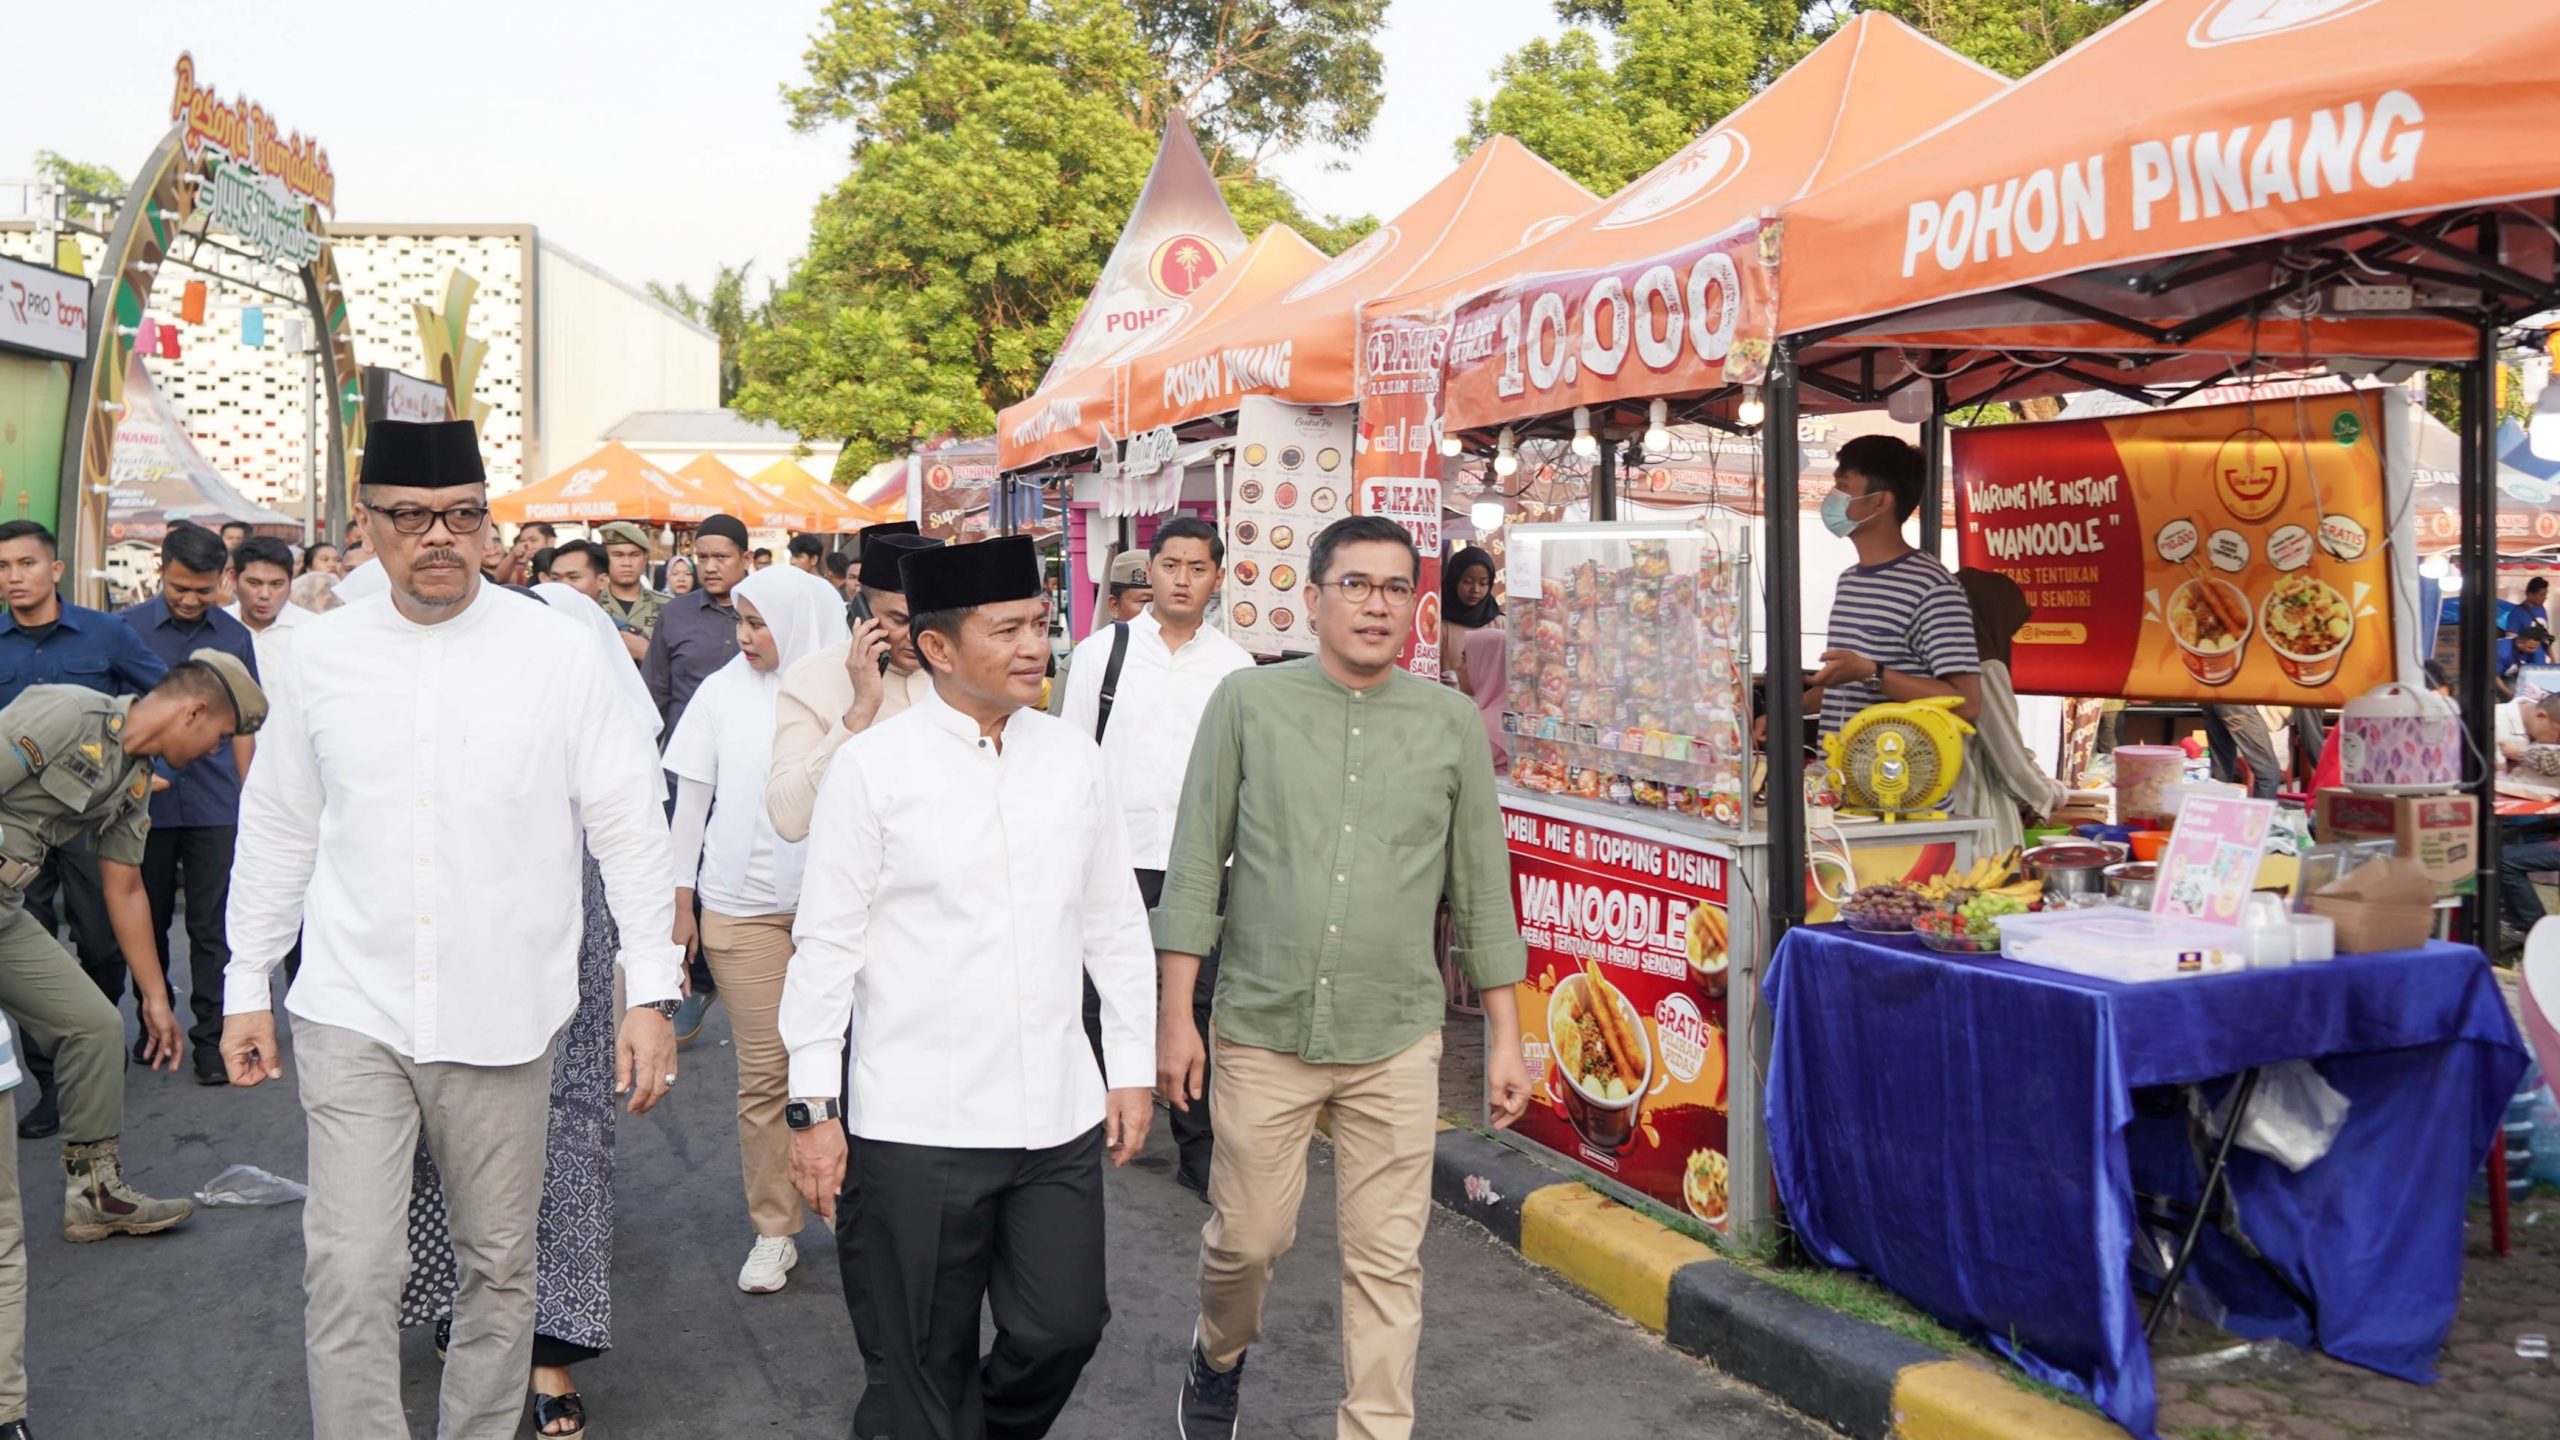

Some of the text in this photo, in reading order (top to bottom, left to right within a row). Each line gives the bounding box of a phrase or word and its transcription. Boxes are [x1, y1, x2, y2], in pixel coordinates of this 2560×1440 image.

[1902, 90, 2425, 278] POHON PINANG
[28, 292, 51, 316] PRO
[1498, 252, 1741, 397] 10.000
[1163, 340, 1293, 409] POHON PINANG
[115, 432, 160, 445] INANG
[1967, 475, 2118, 513] WARUNG MIE INSTANT
[1984, 518, 2105, 560] WANOODLE
[2035, 566, 2098, 584] TENTUKAN
[1545, 822, 1571, 853] MIE
[1575, 829, 1586, 859] &
[1591, 833, 1662, 876] TOPPING
[1667, 850, 1721, 889] DISINI
[1519, 874, 1690, 955] WANOODLE
[1608, 944, 1639, 971] MENU
[1641, 953, 1687, 981] SENDIRI
[1656, 1002, 1709, 1048] GRATIS
